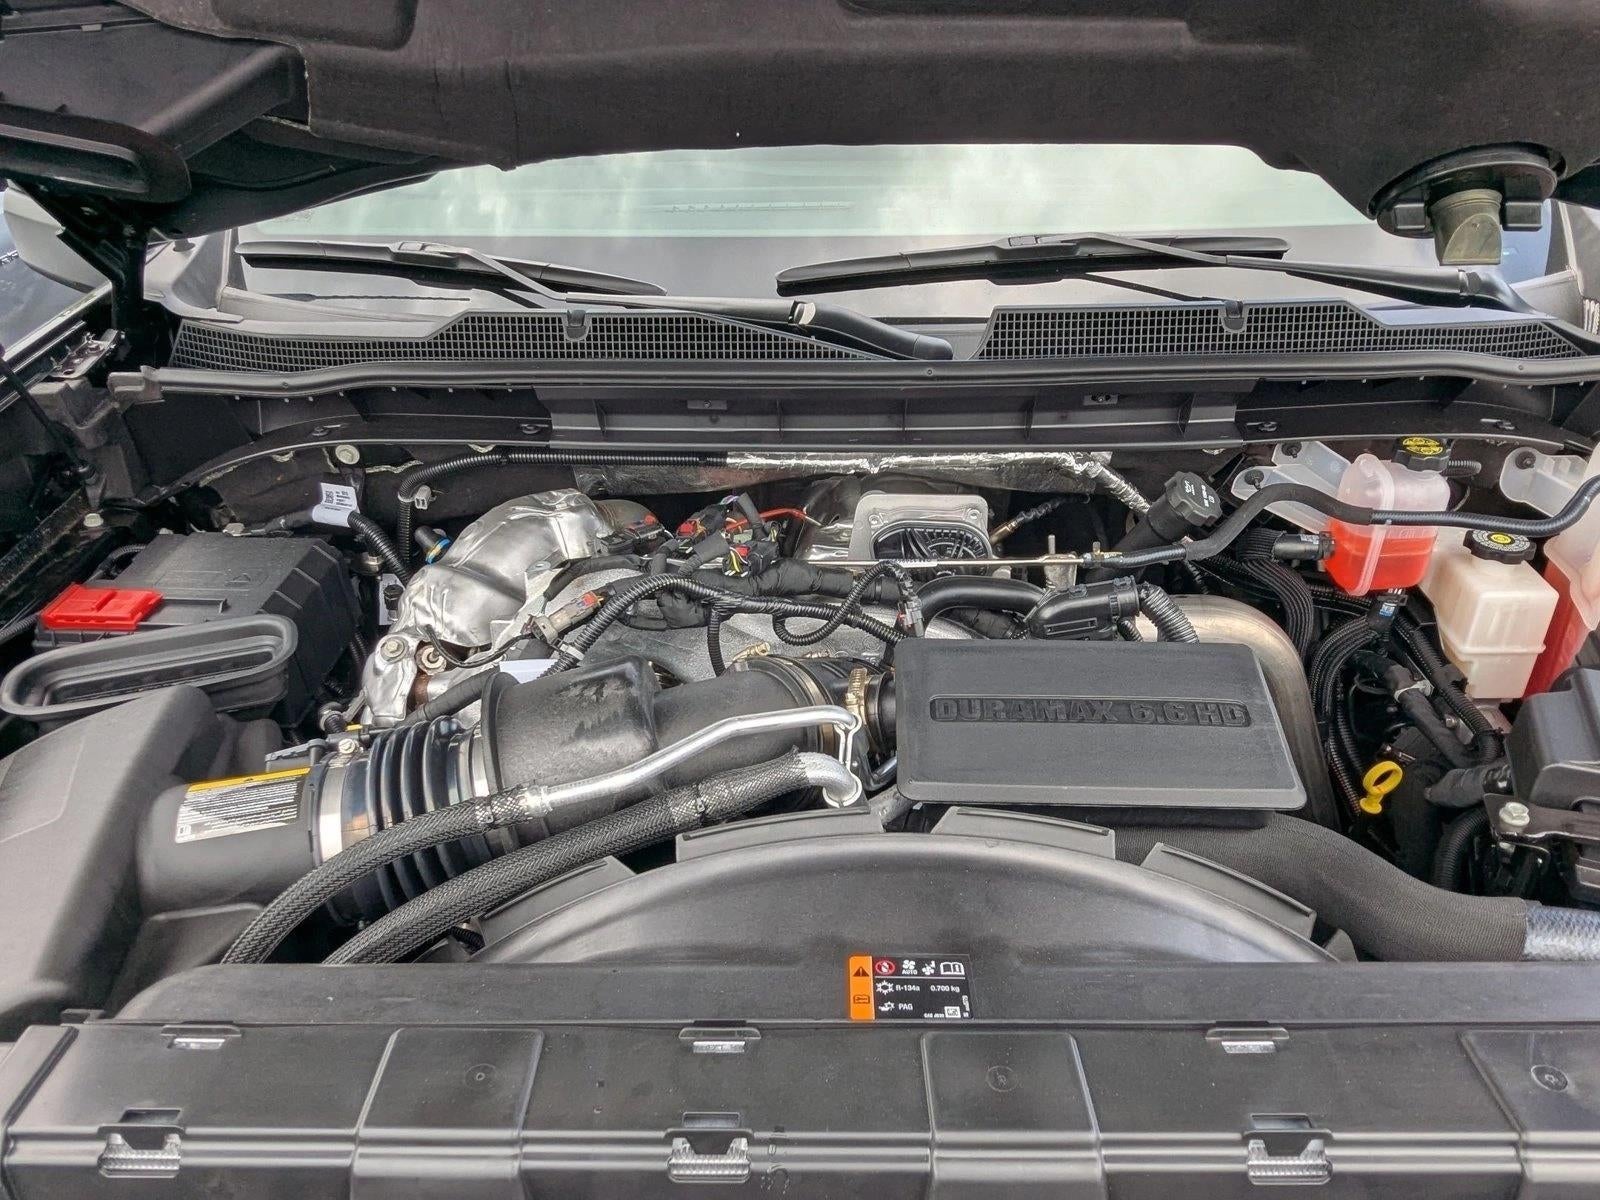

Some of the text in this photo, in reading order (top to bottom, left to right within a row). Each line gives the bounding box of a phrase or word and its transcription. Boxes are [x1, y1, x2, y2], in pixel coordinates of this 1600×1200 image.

[935, 699, 1247, 727] DURAMAX 6.6 HD
[896, 984, 920, 992] R-134a
[951, 984, 960, 993] kg
[898, 1002, 913, 1010] PAG
